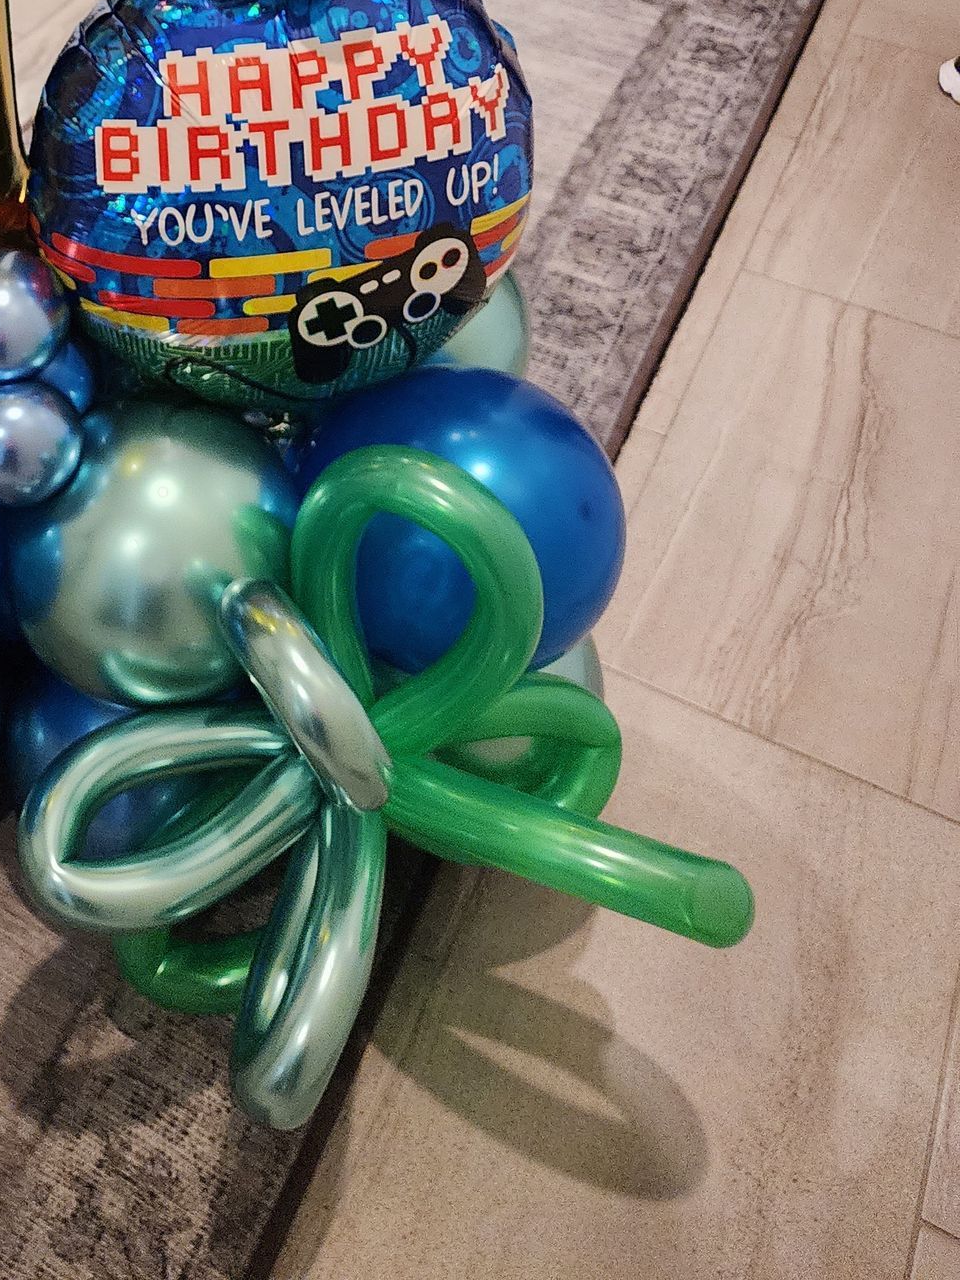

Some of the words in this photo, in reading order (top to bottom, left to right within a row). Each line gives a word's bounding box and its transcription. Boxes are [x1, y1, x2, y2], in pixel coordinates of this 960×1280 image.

[159, 16, 453, 121] HAPPY
[96, 64, 510, 193] BIRTHDAY
[133, 198, 273, 246] YOU'VE
[296, 178, 425, 237] LEVELED
[446, 153, 501, 206] UP!
